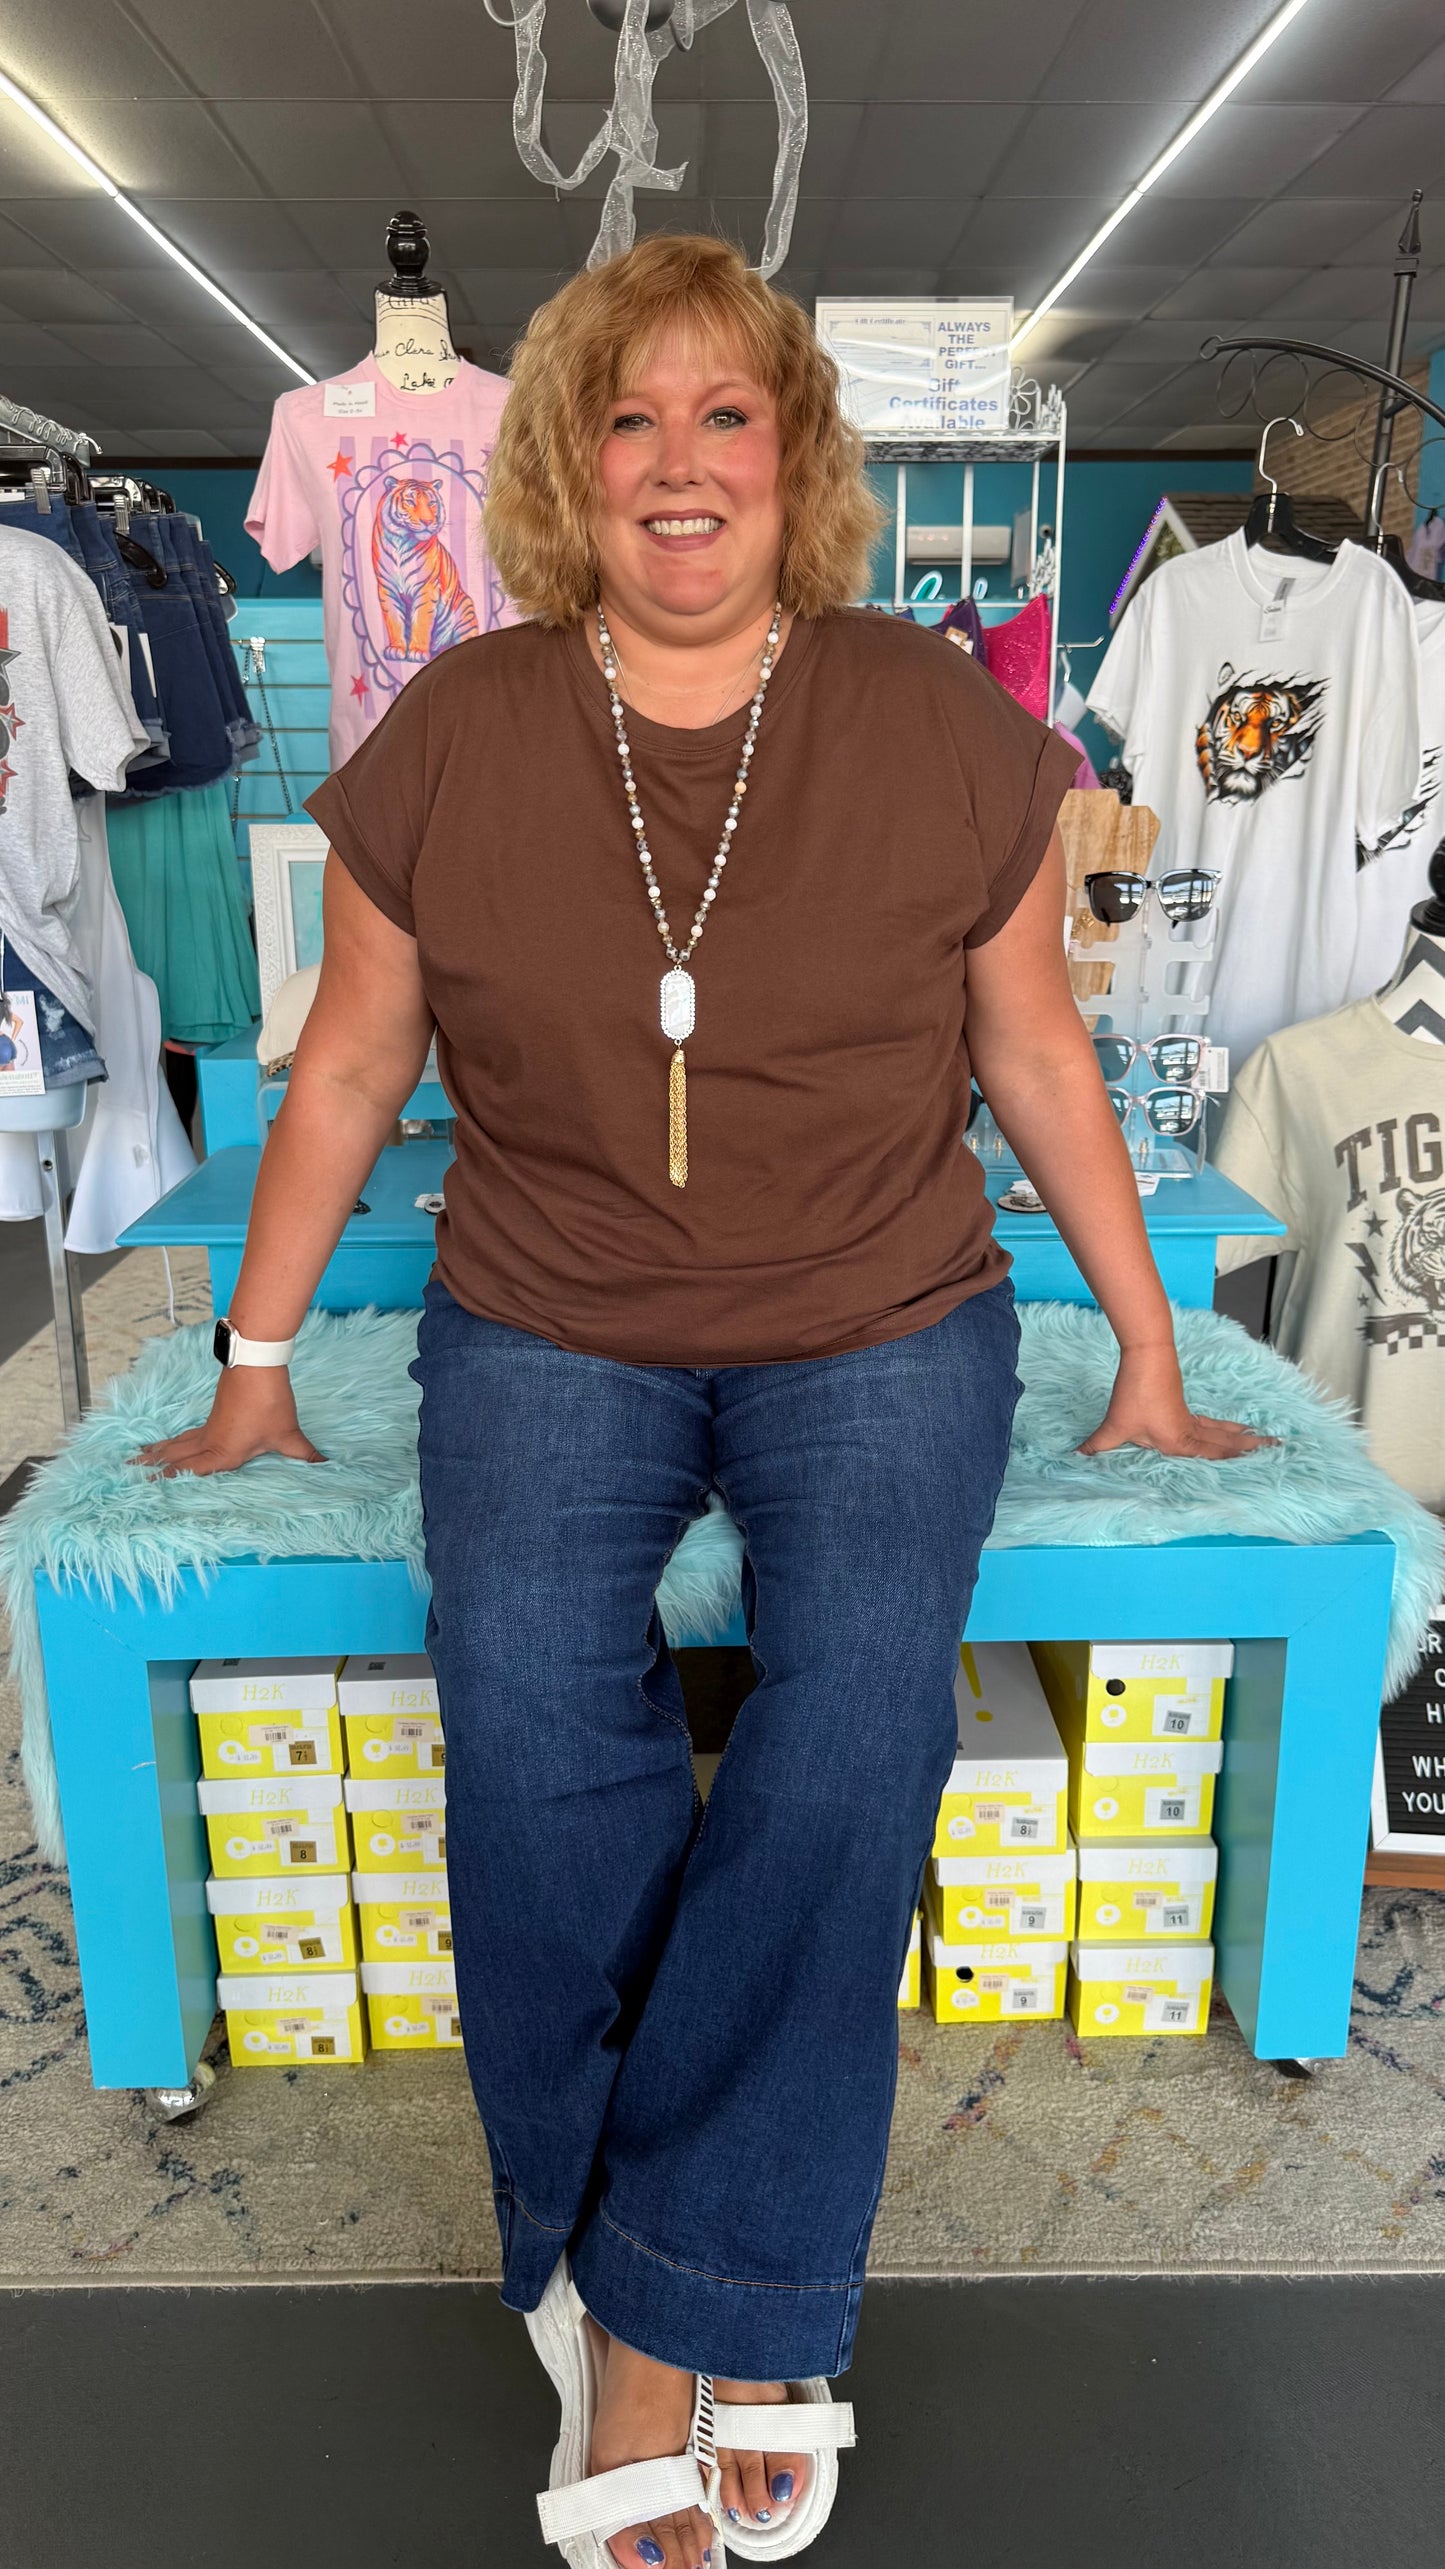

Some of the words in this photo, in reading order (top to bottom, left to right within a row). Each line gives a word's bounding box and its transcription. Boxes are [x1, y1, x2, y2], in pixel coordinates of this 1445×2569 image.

[937, 321, 991, 332] ALWAYS
[948, 334, 975, 344] THE
[889, 396, 998, 411] Certificates
[1334, 1112, 1444, 1213] TIG
[1140, 1653, 1184, 1670] H2K
[242, 1683, 286, 1701] H2K
[390, 1689, 434, 1708] H2K
[1171, 1718, 1185, 1730] 10
[1132, 1751, 1176, 1770] H2K
[975, 1769, 1019, 1787] H2K
[249, 1787, 293, 1806] H2K
[395, 1786, 438, 1804] H2K
[1166, 1806, 1180, 1817] 10
[300, 1849, 307, 1860] 8
[986, 1861, 1029, 1879] H2K
[1127, 1856, 1170, 1876] H2K
[403, 1879, 445, 1897] H2K
[256, 1888, 299, 1908] H2K
[1169, 1914, 1184, 1925] 11
[1125, 1956, 1168, 1974] H2K
[409, 1969, 452, 1987] H2K
[267, 1985, 310, 2003] H2K
[1169, 2010, 1182, 2021] 11
